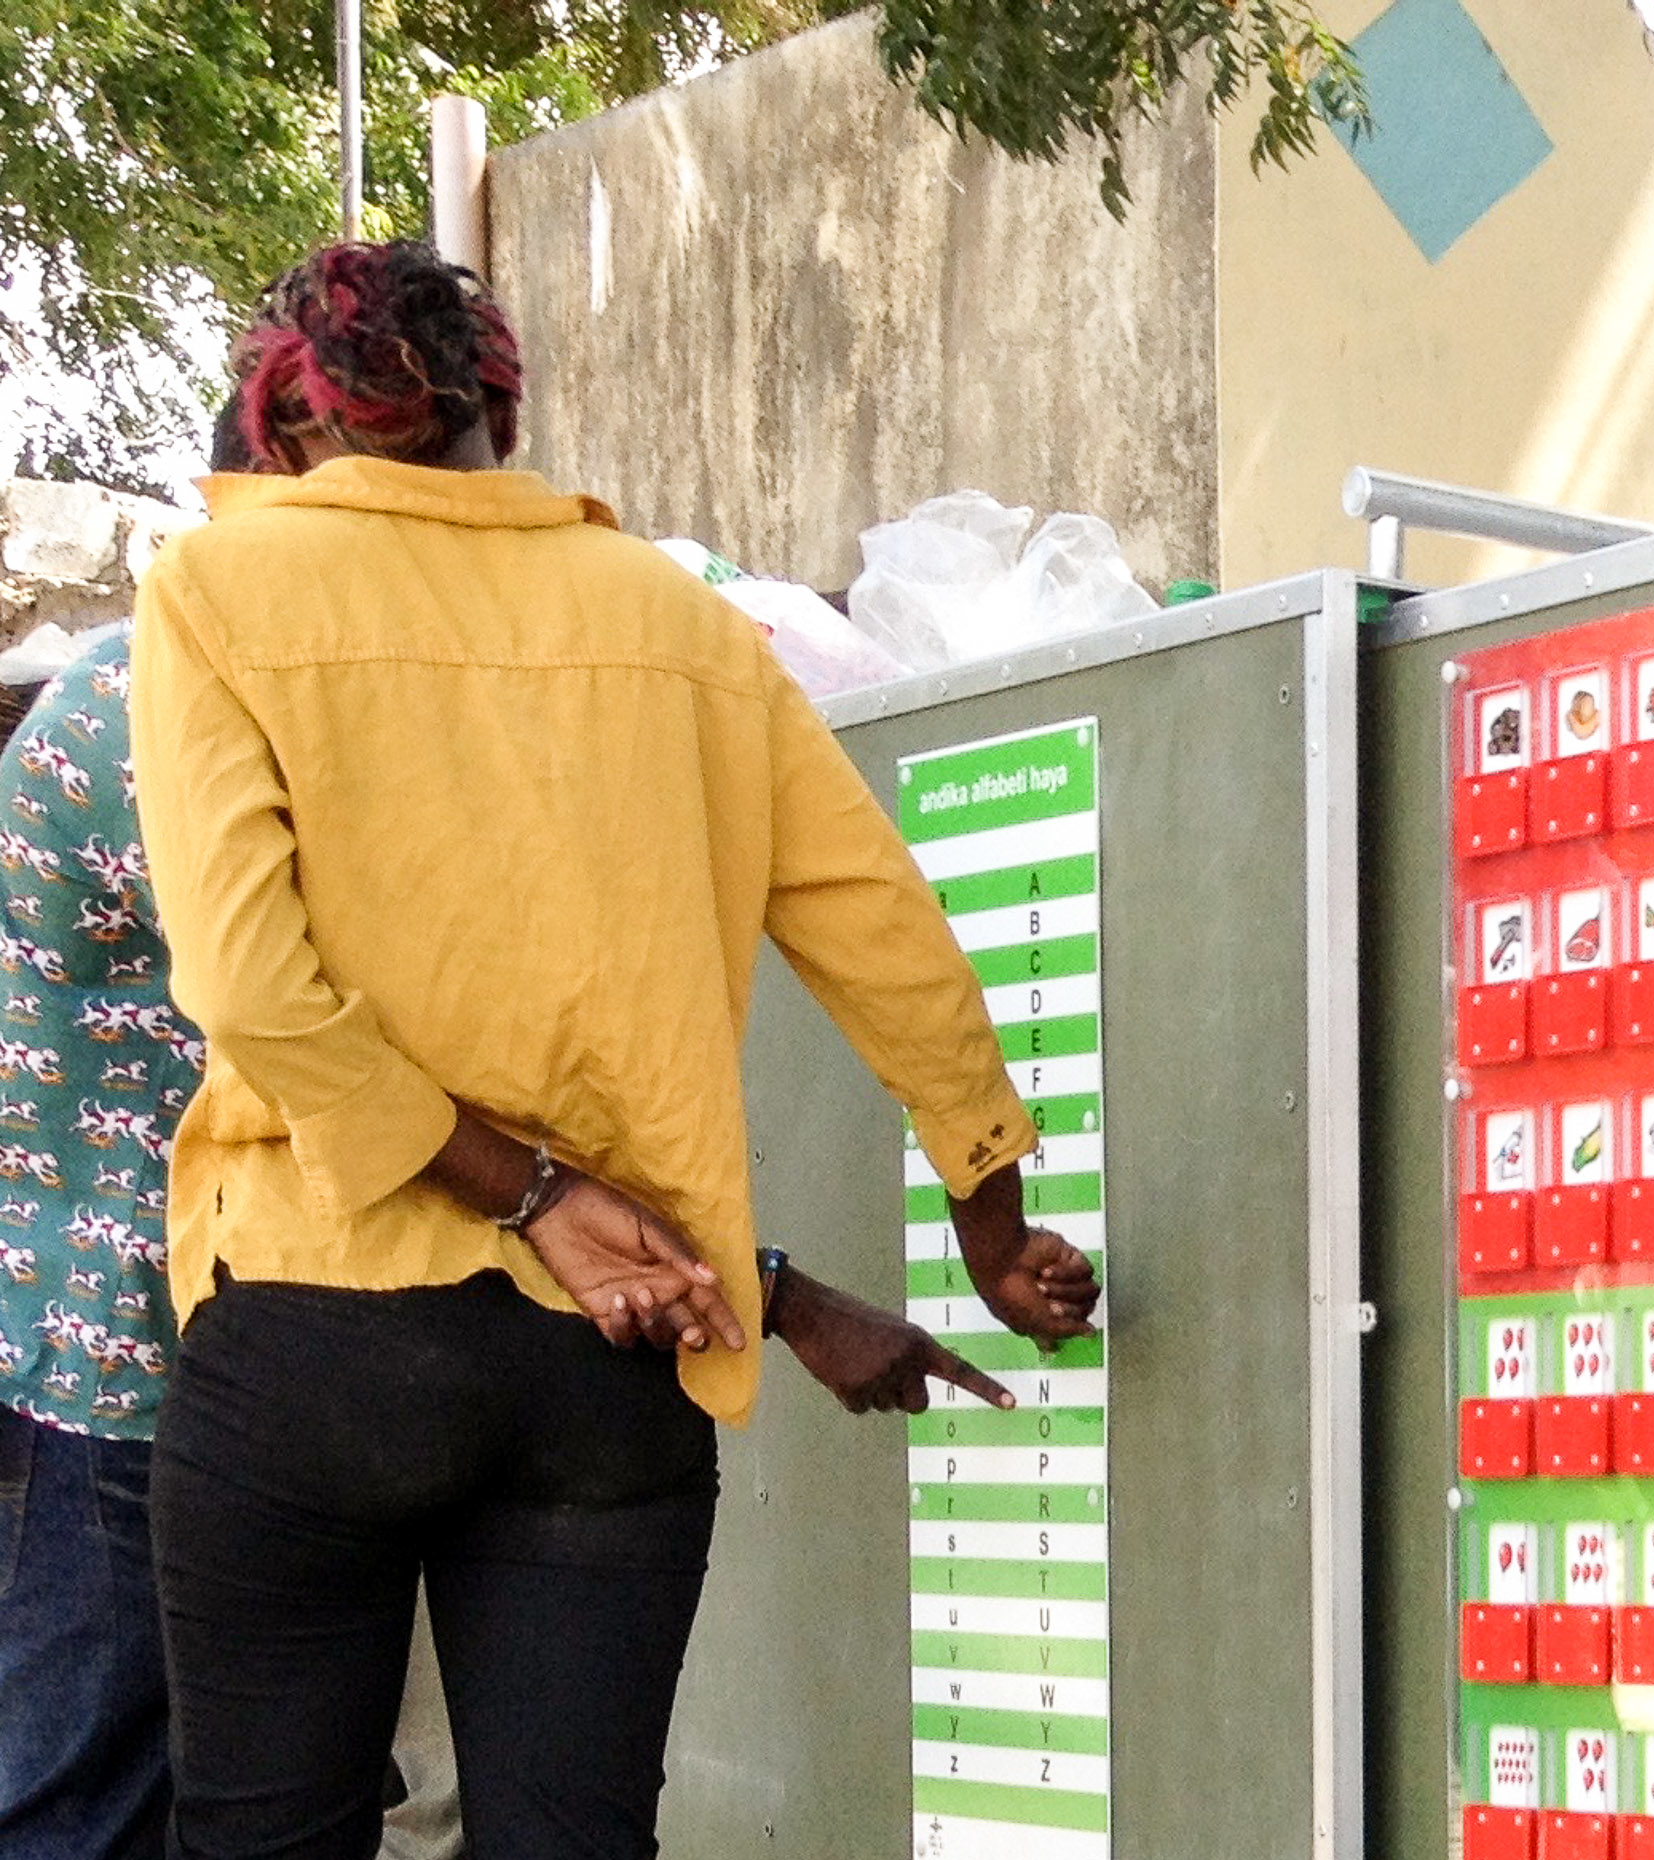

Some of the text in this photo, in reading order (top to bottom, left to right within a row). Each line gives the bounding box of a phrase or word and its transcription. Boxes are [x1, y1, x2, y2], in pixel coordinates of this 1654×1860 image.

[919, 765, 1068, 814] andika alfabeti haya
[1029, 873, 1040, 895] A
[1031, 911, 1039, 935] B
[1031, 950, 1040, 974] C
[1031, 990, 1041, 1014] D
[1032, 1028, 1040, 1052] E
[1033, 1068, 1040, 1091] F
[1034, 1106, 1044, 1130] G
[1034, 1146, 1043, 1169] H
[945, 1267, 953, 1287] k
[1039, 1380, 1049, 1403] N
[947, 1415, 1050, 1438] o O
[947, 1453, 1048, 1481] p P
[948, 1494, 1050, 1517] r R
[948, 1532, 1048, 1555] s S
[1039, 1570, 1048, 1592] T
[950, 1608, 1049, 1632] u U
[1040, 1647, 1050, 1669] V
[950, 1684, 1054, 1707] w W
[1041, 1722, 1049, 1743] Y
[951, 1756, 1050, 1782] z Z
